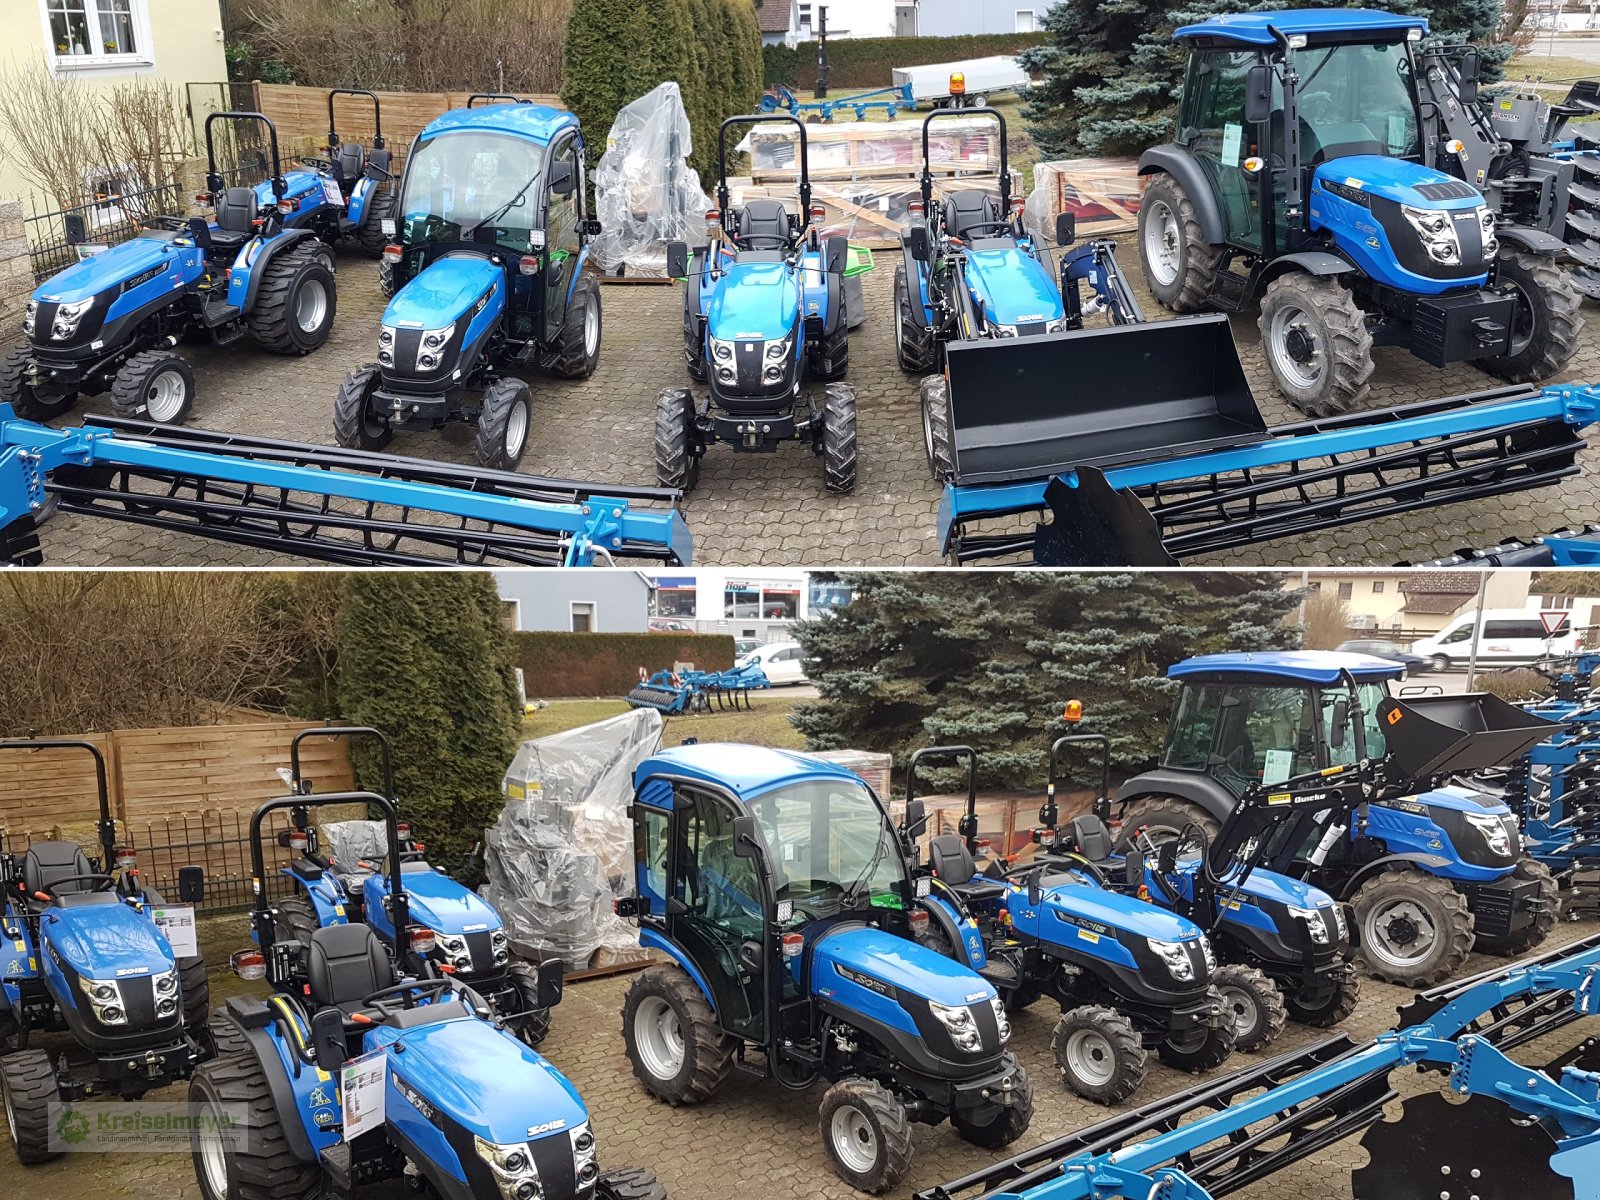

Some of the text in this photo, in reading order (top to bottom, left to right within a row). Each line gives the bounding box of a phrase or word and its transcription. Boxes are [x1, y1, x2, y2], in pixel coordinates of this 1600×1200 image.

[1294, 793, 1326, 804] Quicke
[1413, 828, 1440, 837] SUPER
[526, 1119, 565, 1137] SOLIS
